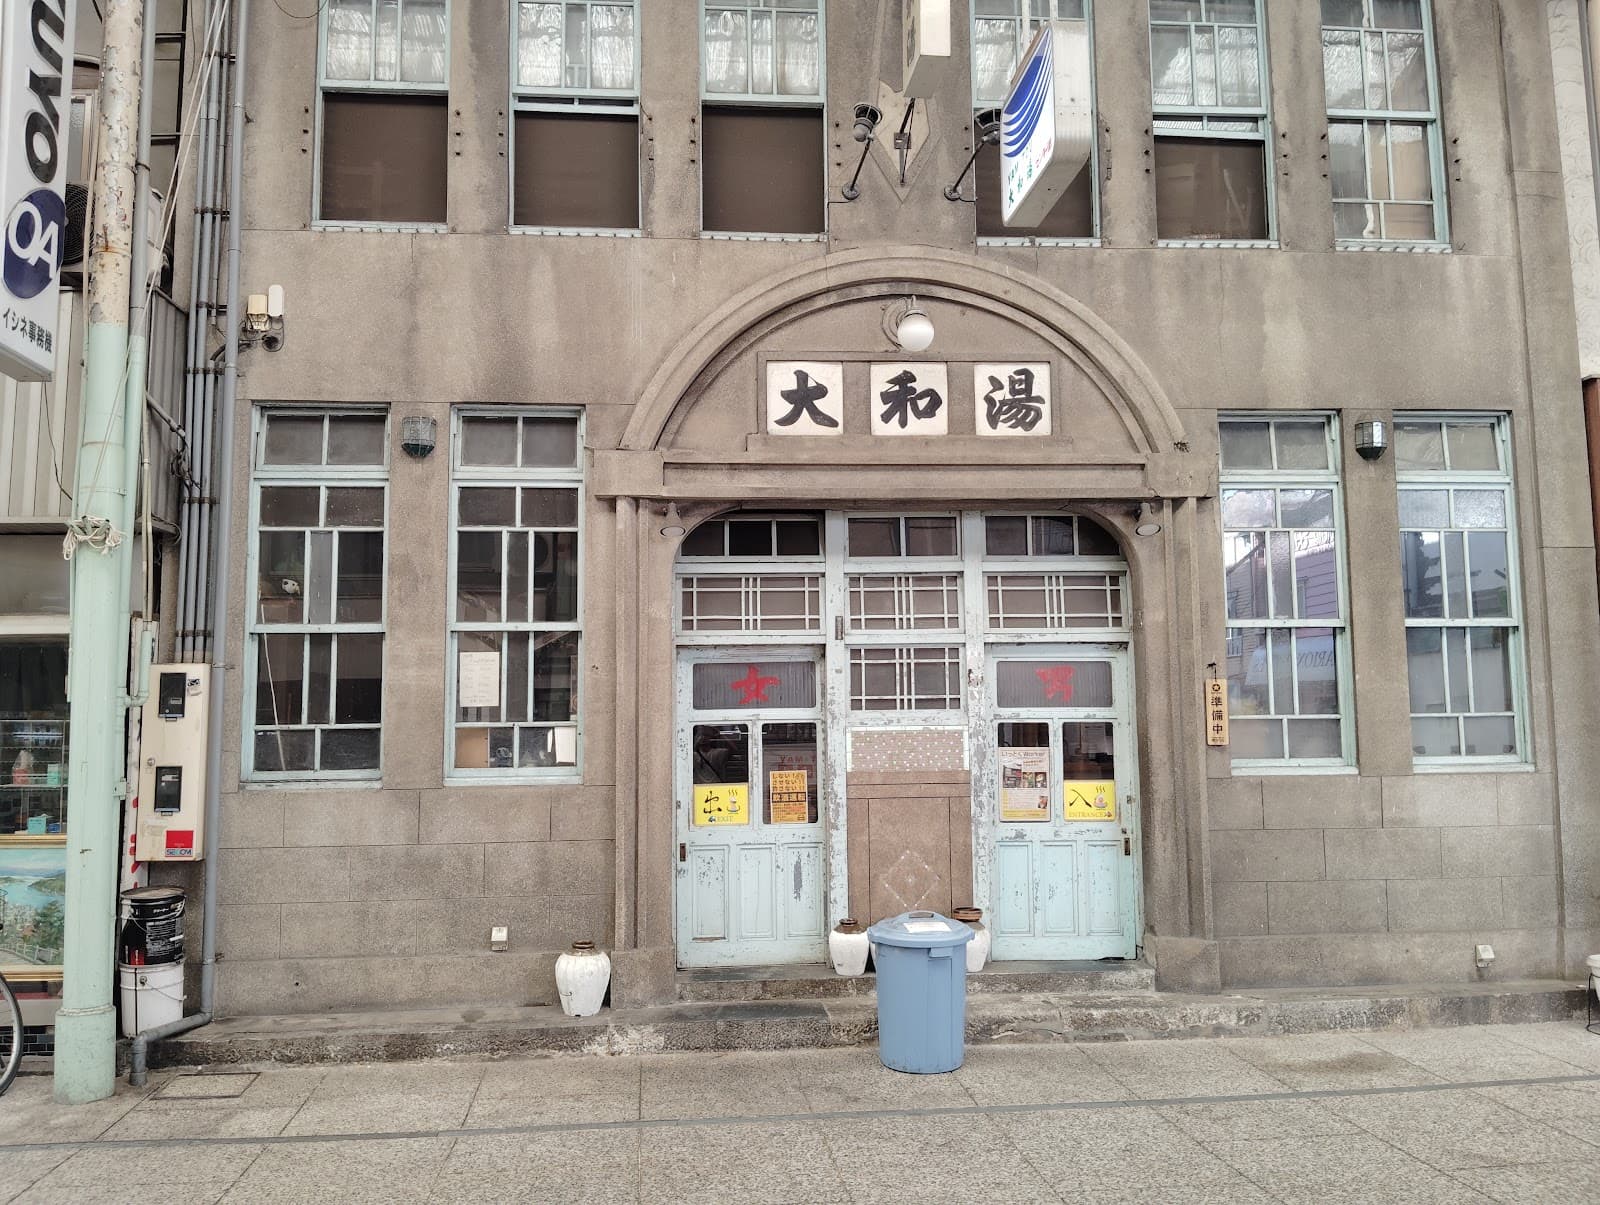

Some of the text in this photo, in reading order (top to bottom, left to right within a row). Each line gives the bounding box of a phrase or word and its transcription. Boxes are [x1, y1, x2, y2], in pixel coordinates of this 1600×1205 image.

[8, 200, 59, 280] OA
[3, 307, 52, 354] イシネ事務機
[774, 367, 1046, 431] 大和湯
[731, 664, 781, 704] 女
[1210, 696, 1224, 735] 準備中
